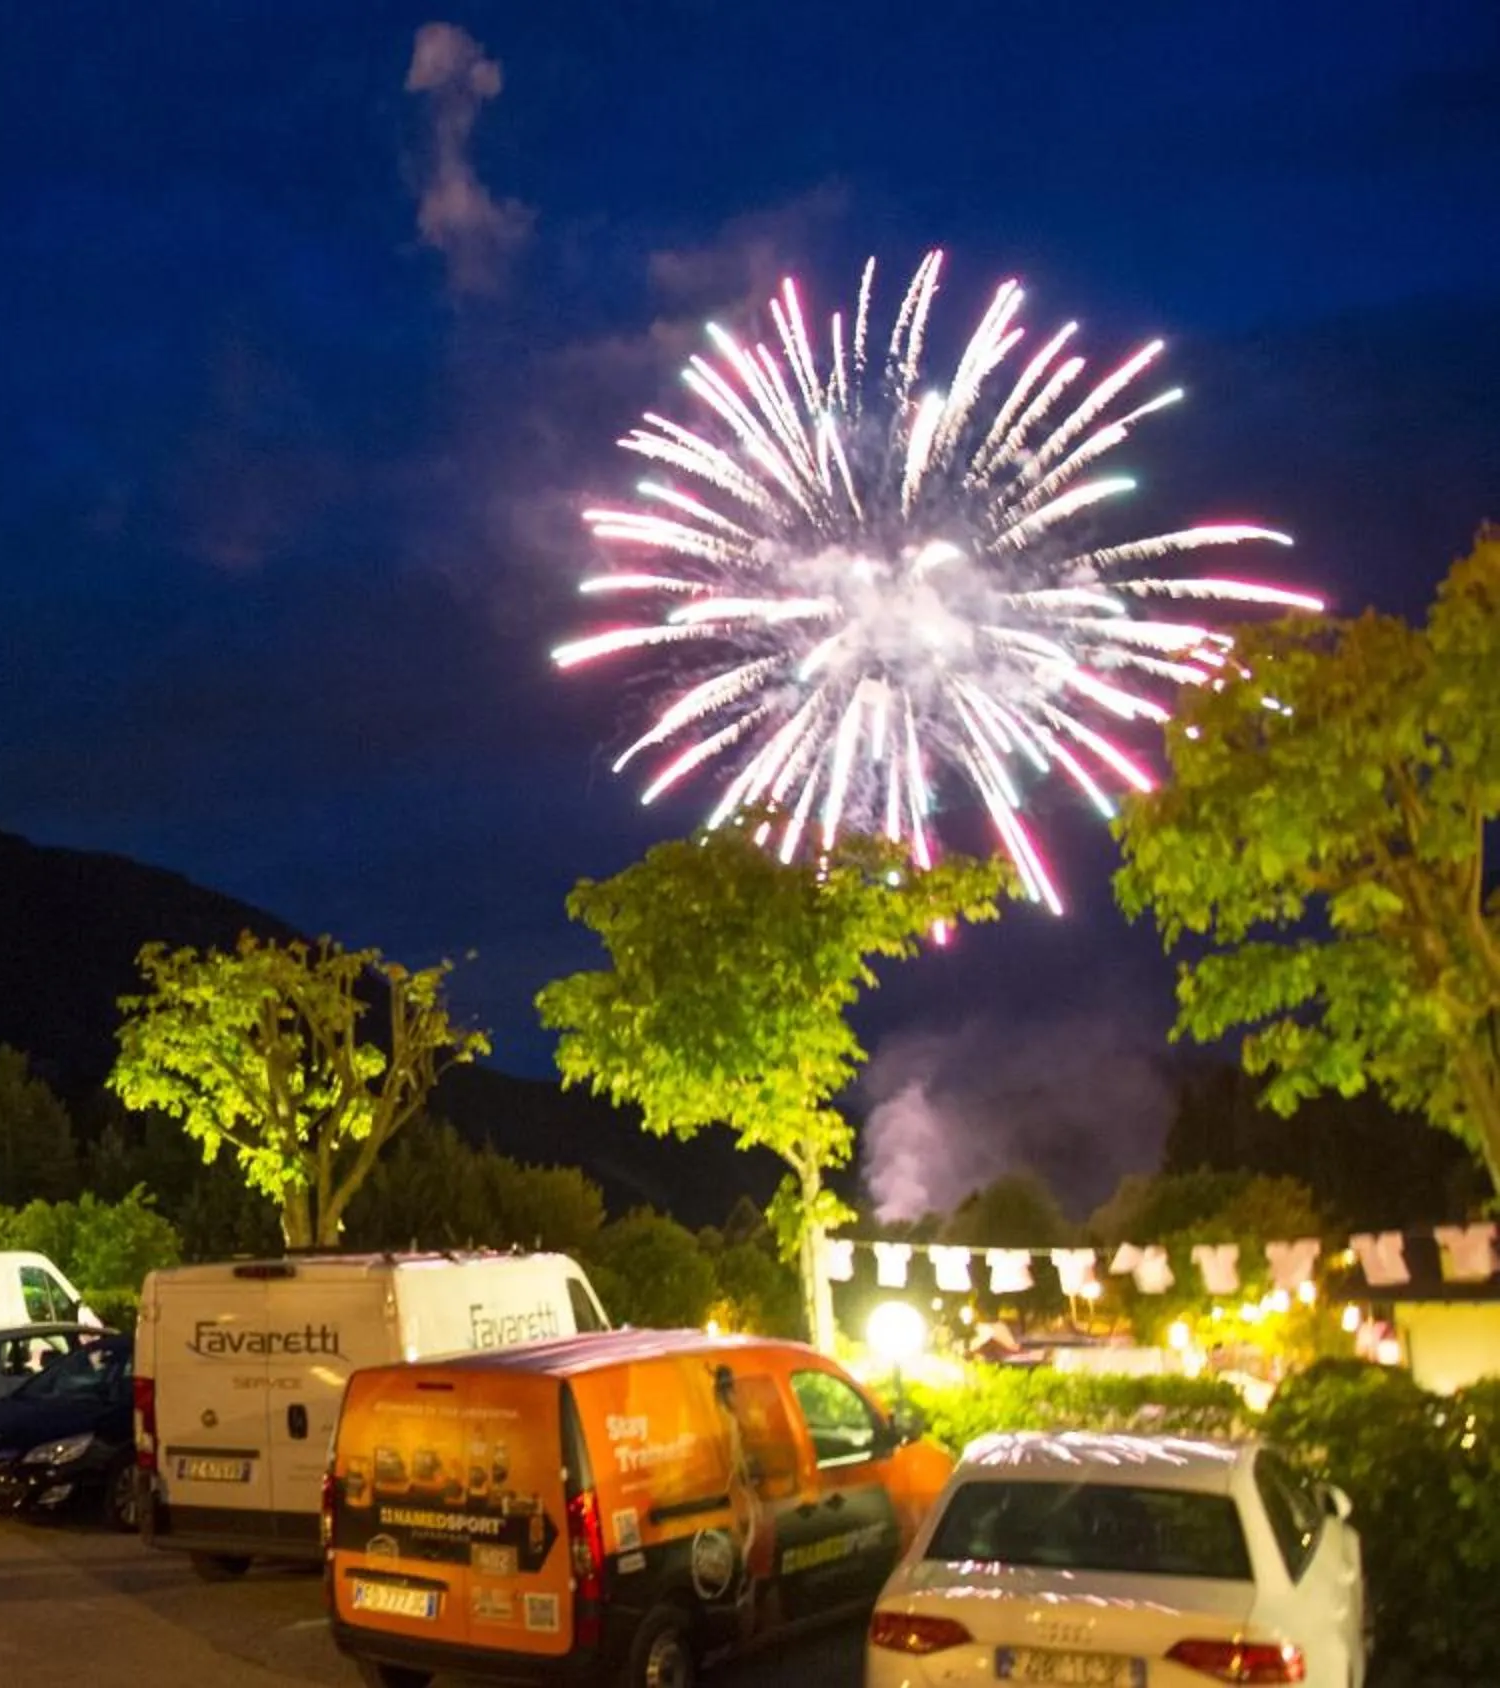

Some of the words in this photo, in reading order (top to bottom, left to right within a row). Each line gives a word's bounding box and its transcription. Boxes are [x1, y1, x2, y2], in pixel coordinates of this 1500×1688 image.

[193, 1321, 340, 1355] Favaretti
[605, 1414, 648, 1442] Stay
[393, 1507, 500, 1535] NAMEDSPORT
